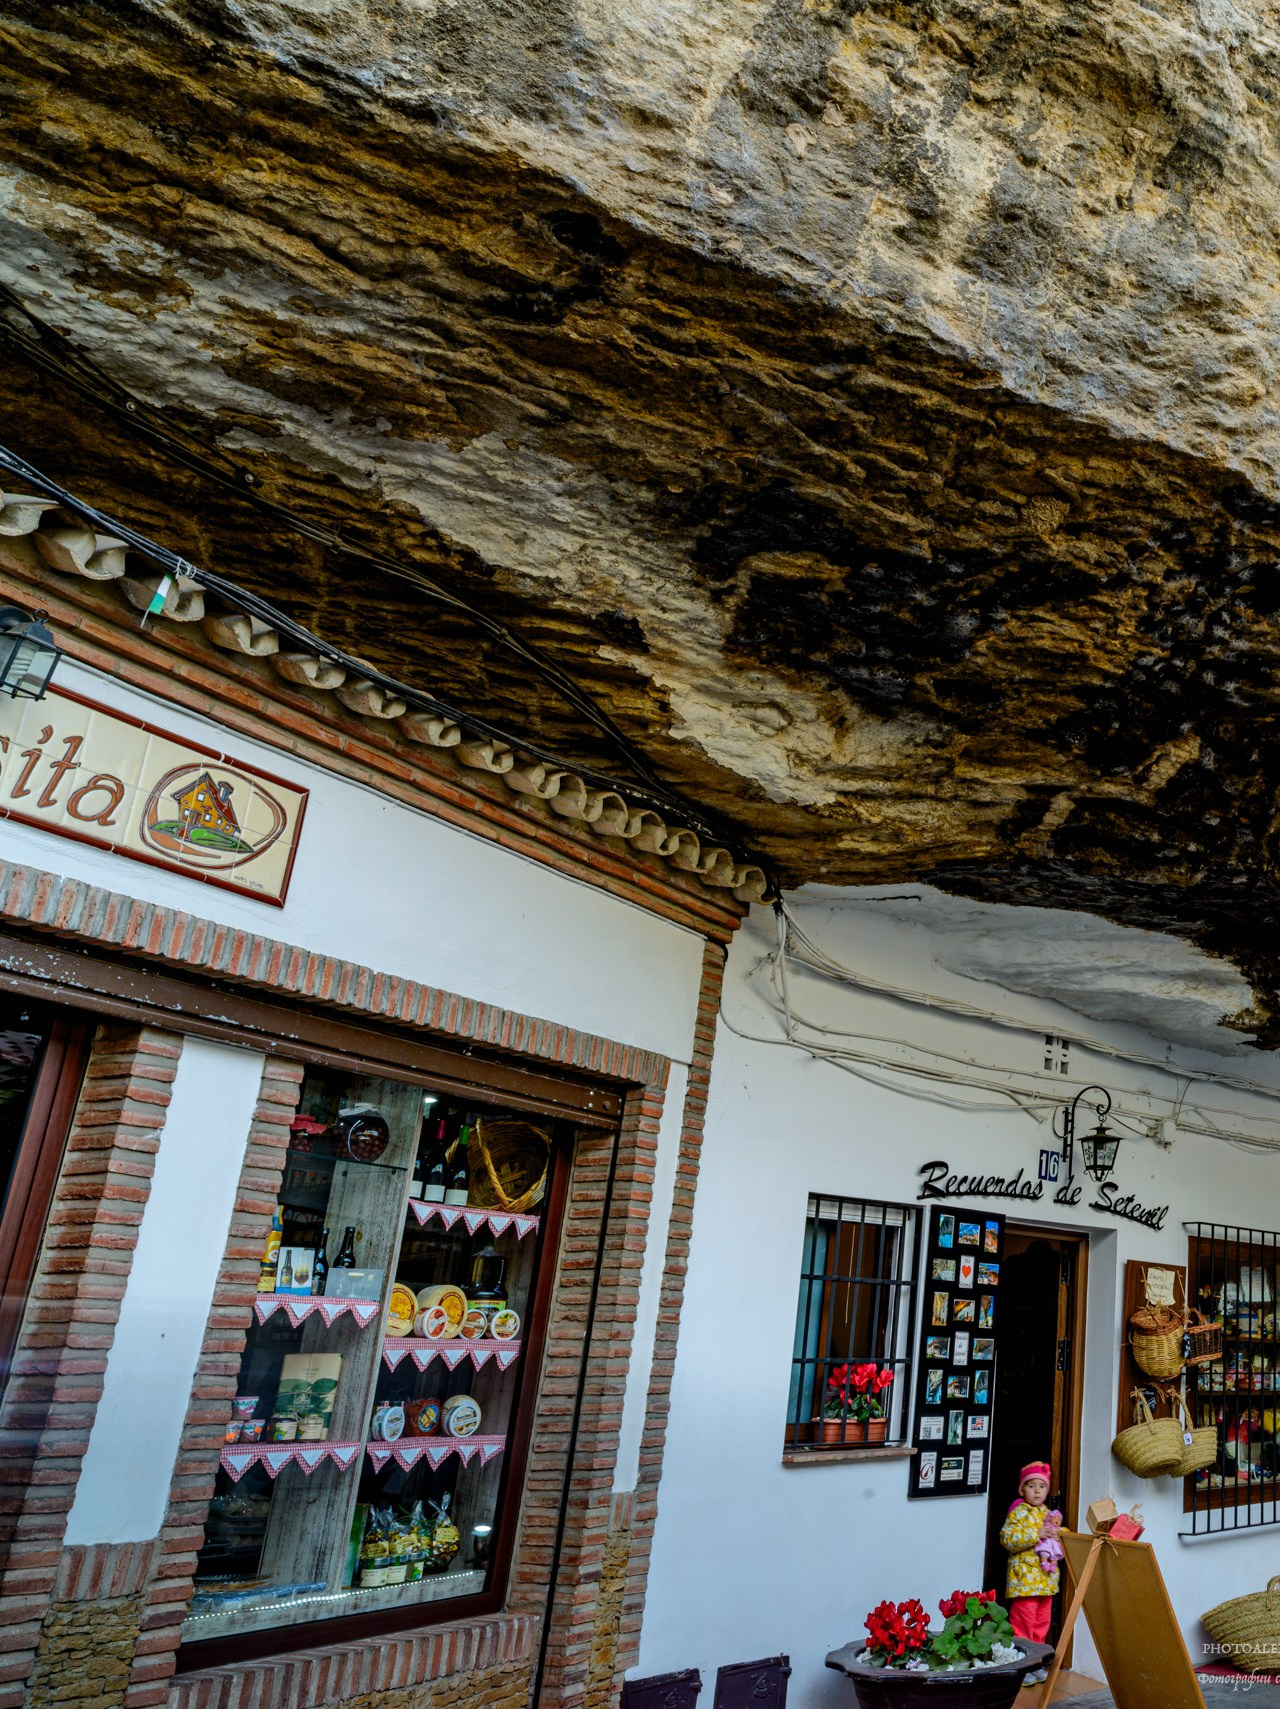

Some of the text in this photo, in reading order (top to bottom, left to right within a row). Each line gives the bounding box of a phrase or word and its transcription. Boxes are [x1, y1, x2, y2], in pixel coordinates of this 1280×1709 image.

[1039, 1152, 1059, 1178] 16
[917, 1161, 1169, 1230] Recuerdos de Setenil
